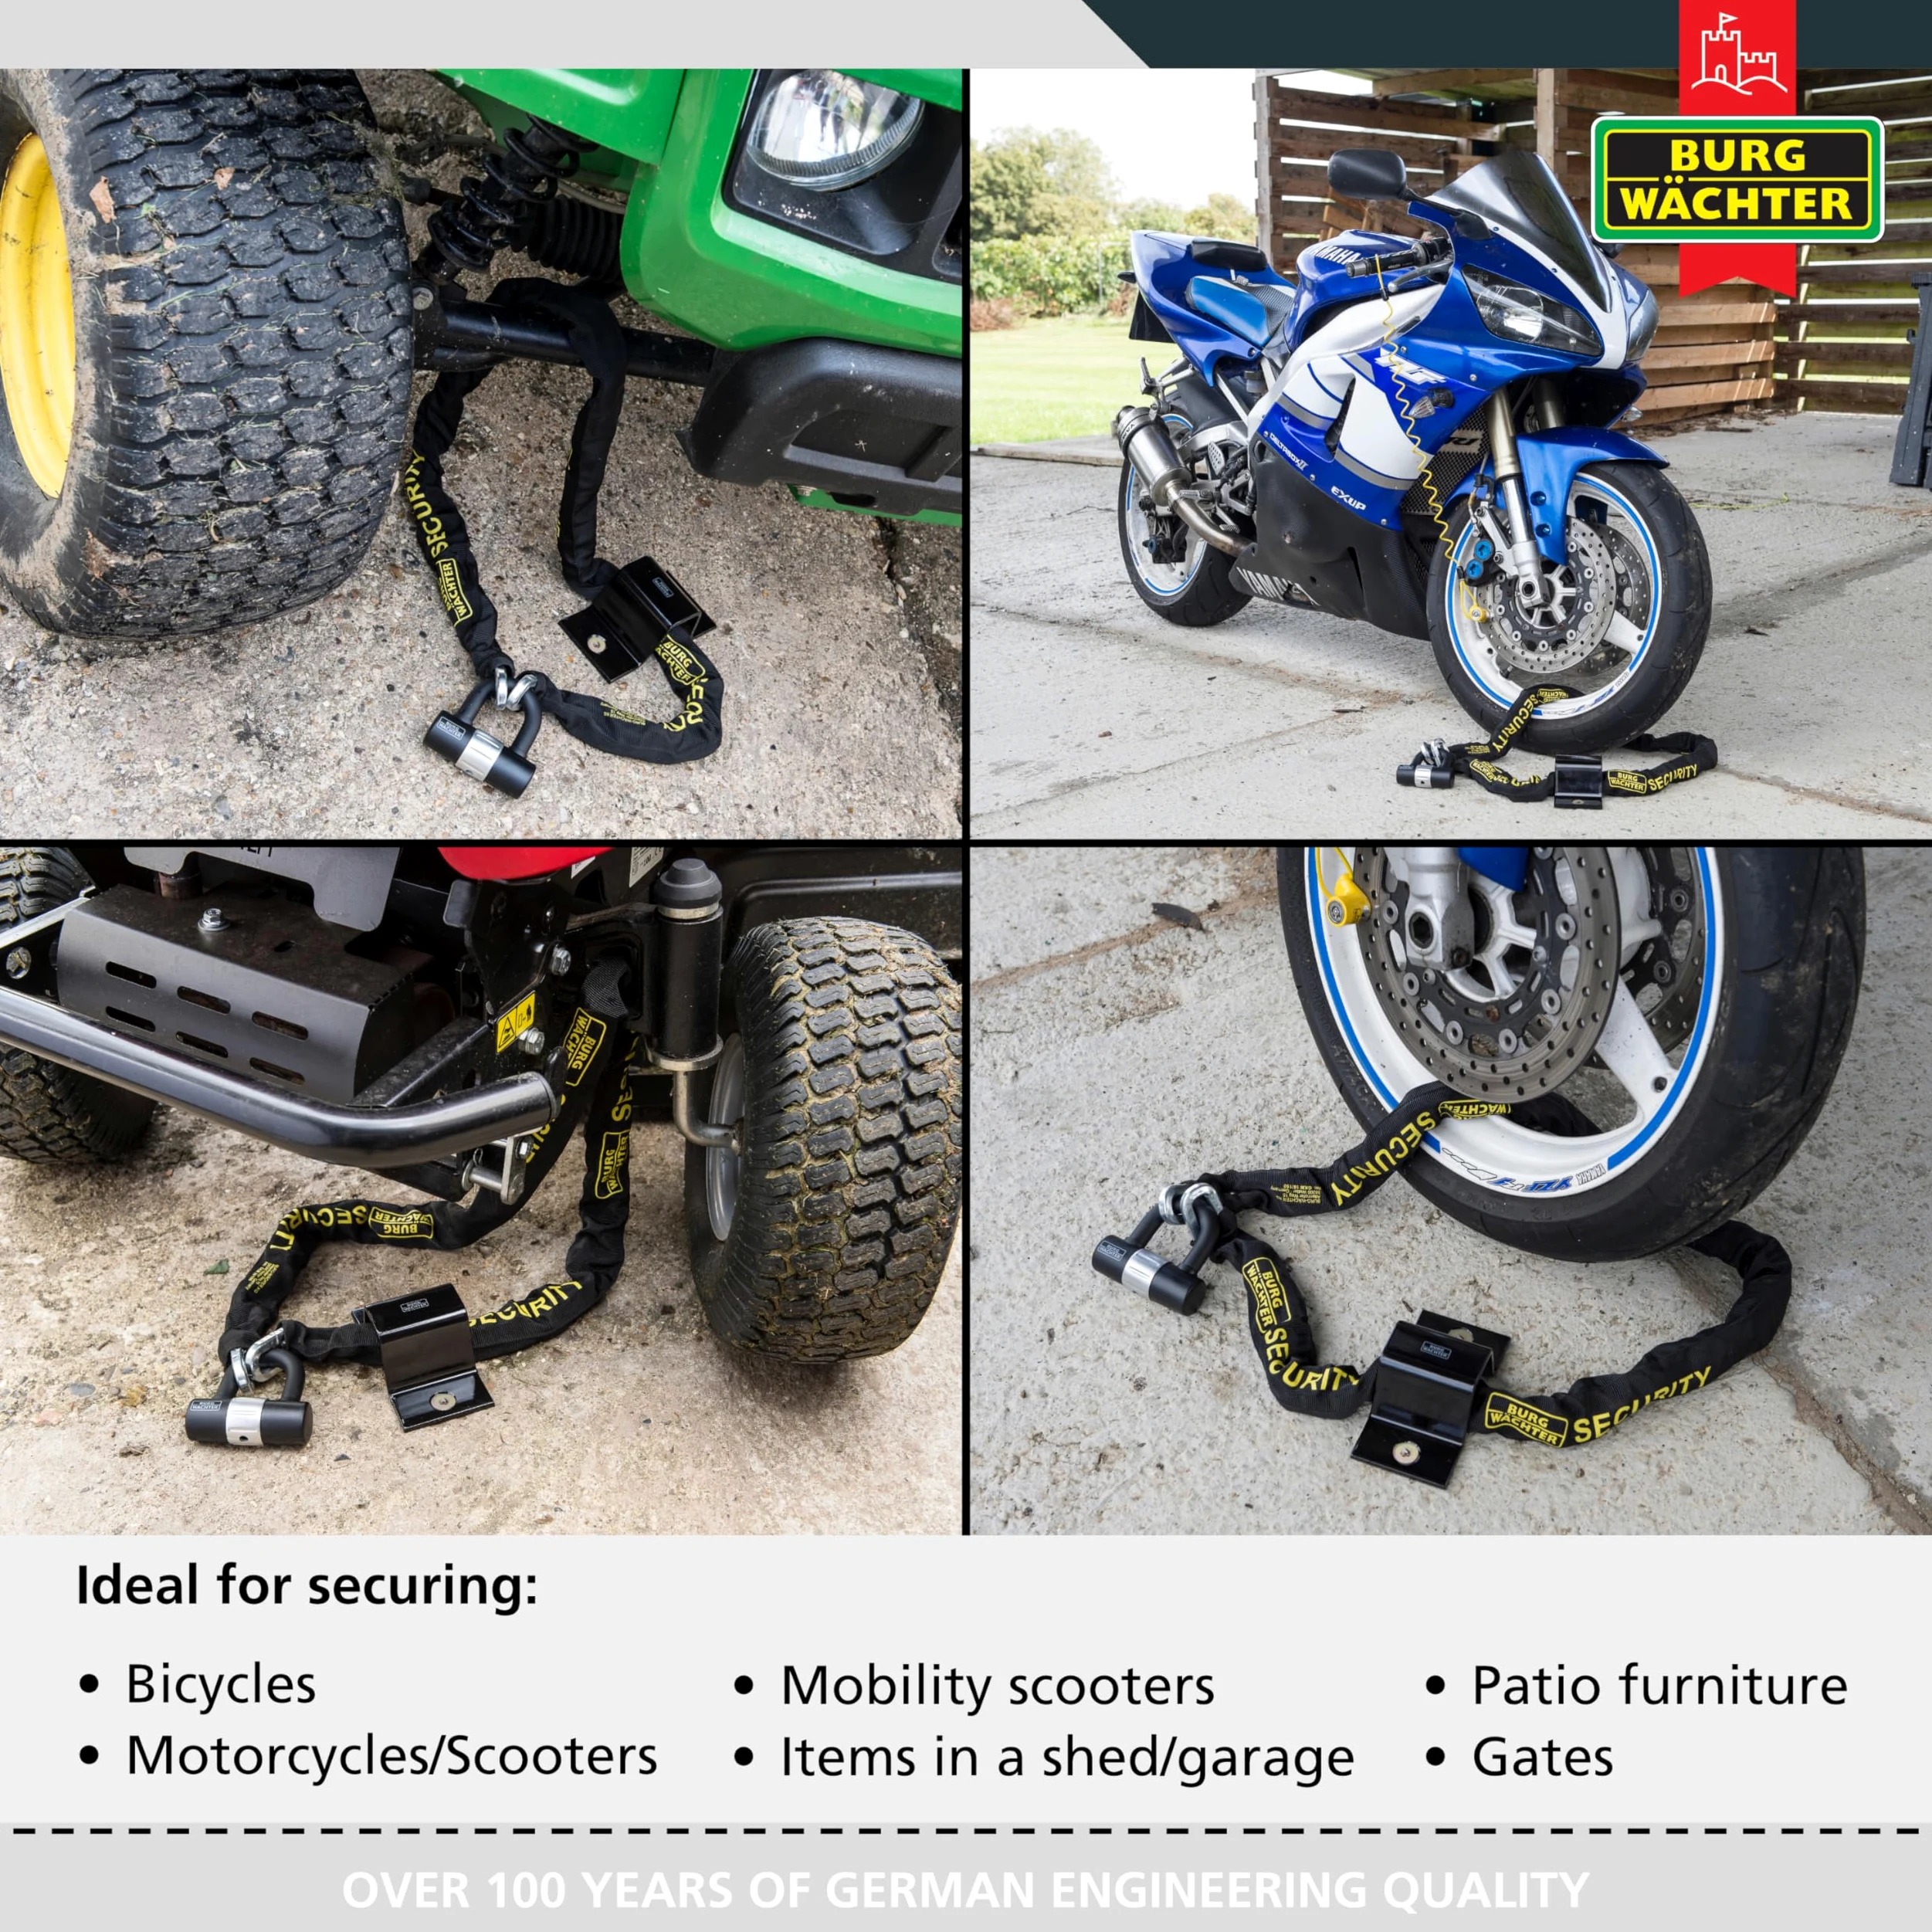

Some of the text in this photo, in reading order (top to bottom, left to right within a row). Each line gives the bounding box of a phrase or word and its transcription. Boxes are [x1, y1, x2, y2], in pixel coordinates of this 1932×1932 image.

[405, 449, 449, 558] SECURITY
[1330, 485, 1367, 510] EXUP
[442, 561, 468, 617] WÄCHTER
[655, 643, 692, 683] ÄCHTER
[663, 640, 693, 669] BURG
[1493, 694, 1538, 753] SECURITY
[1617, 771, 1639, 781] BURG
[572, 1035, 596, 1070] BURG
[1330, 1111, 1436, 1206] SECURITY
[384, 1224, 418, 1234] BURG
[1246, 1265, 1274, 1327] WÄCHTER
[1263, 1271, 1283, 1310] BURG
[1490, 1412, 1558, 1446] WÄCHTER
[1507, 1403, 1549, 1429] BURG
